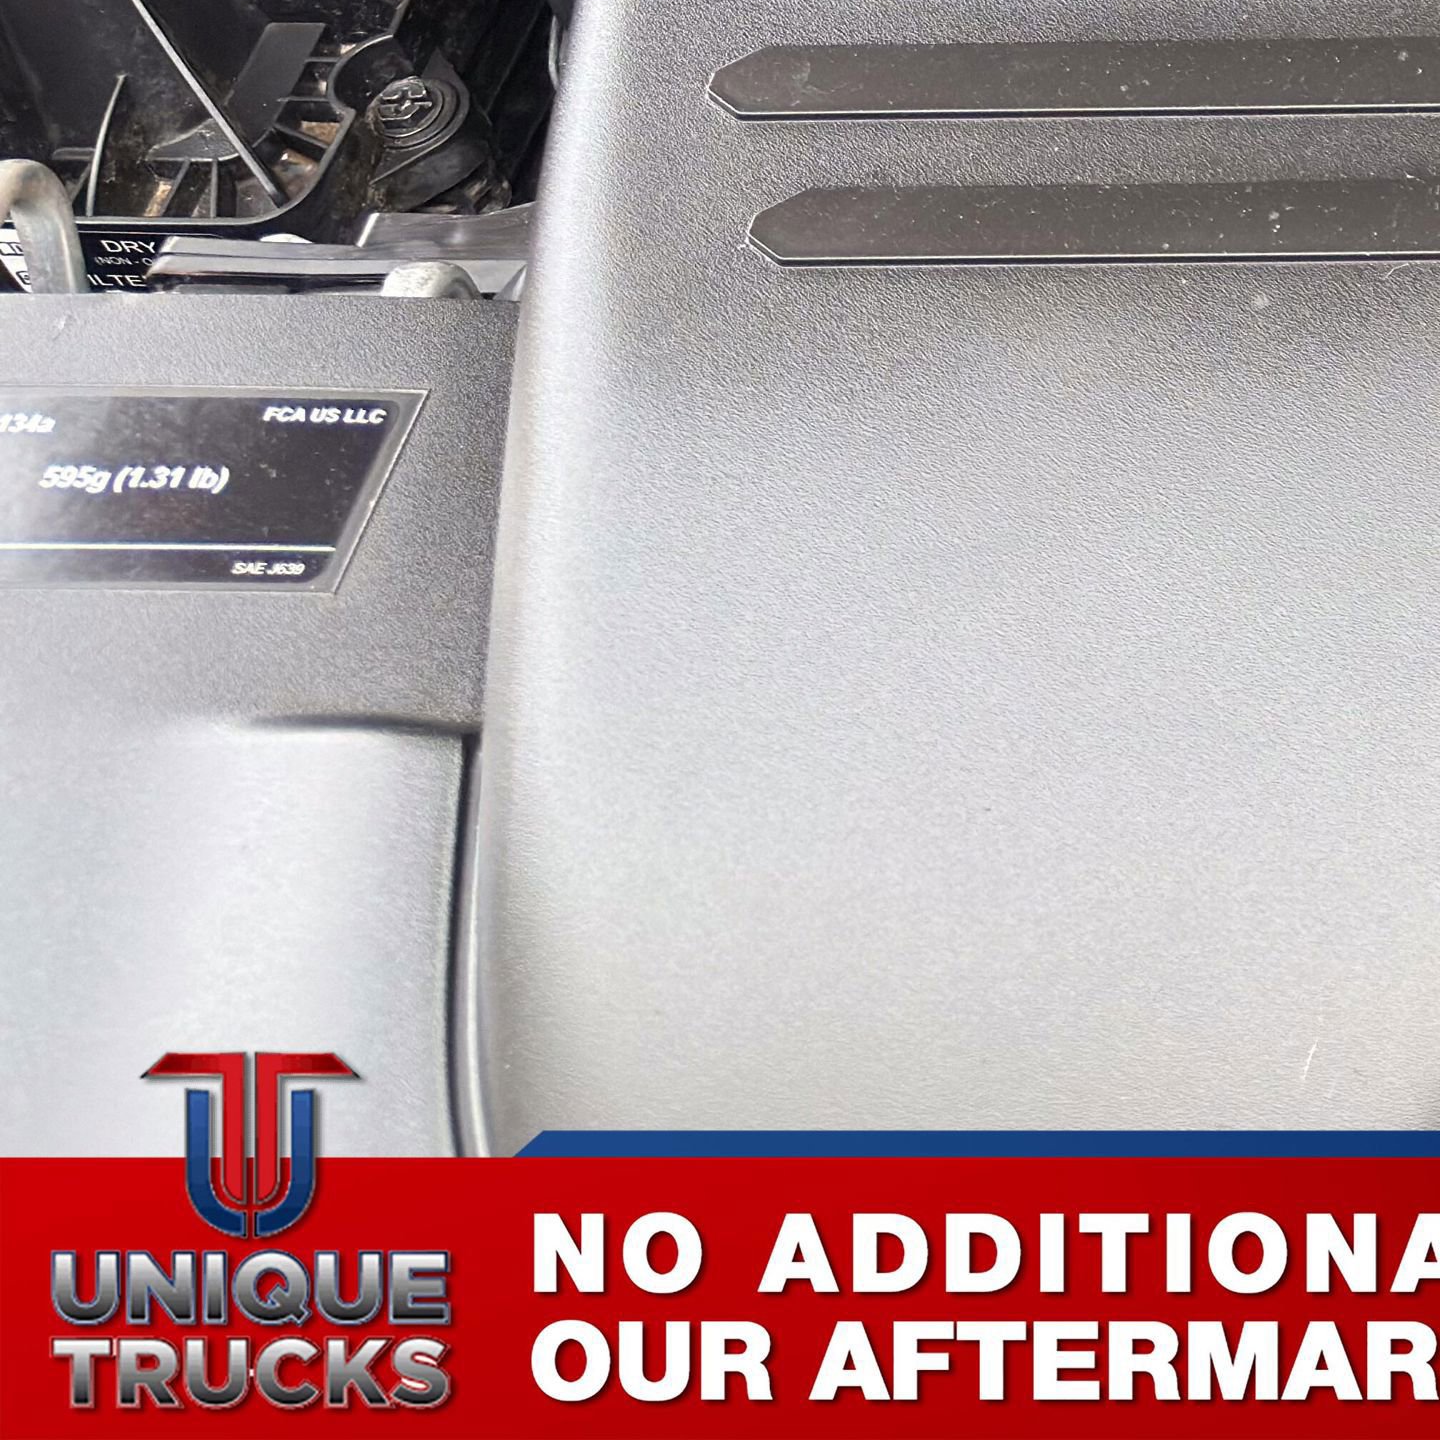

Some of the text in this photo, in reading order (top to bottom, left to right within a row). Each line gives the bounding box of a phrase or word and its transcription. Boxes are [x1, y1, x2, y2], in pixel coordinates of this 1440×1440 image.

[100, 239, 157, 254] DRY
[263, 406, 388, 425] FCA US LLC
[38, 465, 231, 495] 595g (1.31 lb)
[230, 561, 267, 575] SAE
